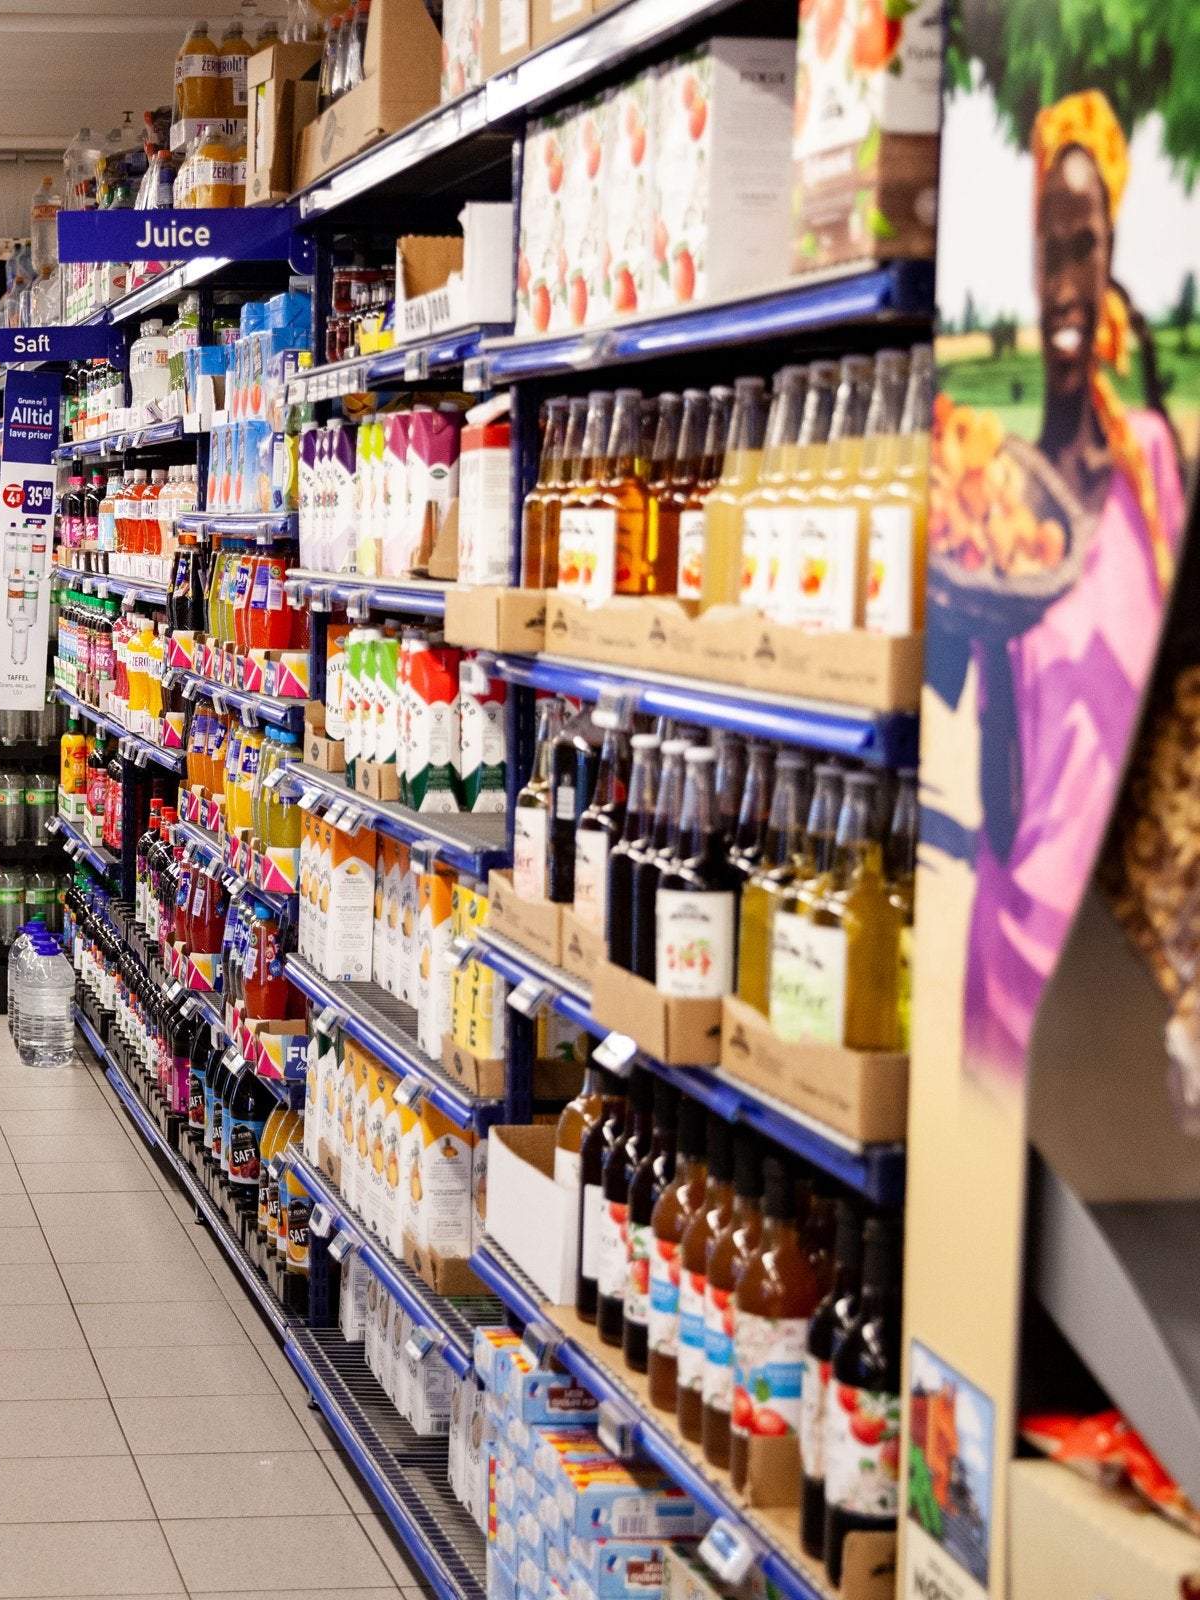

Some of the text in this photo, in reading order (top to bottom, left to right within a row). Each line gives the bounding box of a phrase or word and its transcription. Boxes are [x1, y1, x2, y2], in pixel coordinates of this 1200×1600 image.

[136, 220, 211, 248] Juice
[404, 304, 426, 330] REMA
[14, 334, 51, 353] Saft
[18, 397, 36, 405] Grunn
[10, 406, 53, 426] Alltid
[9, 428, 53, 440] lave priser
[8, 492, 15, 505] 4
[27, 485, 42, 506] 35
[233, 1148, 256, 1164] SAFT
